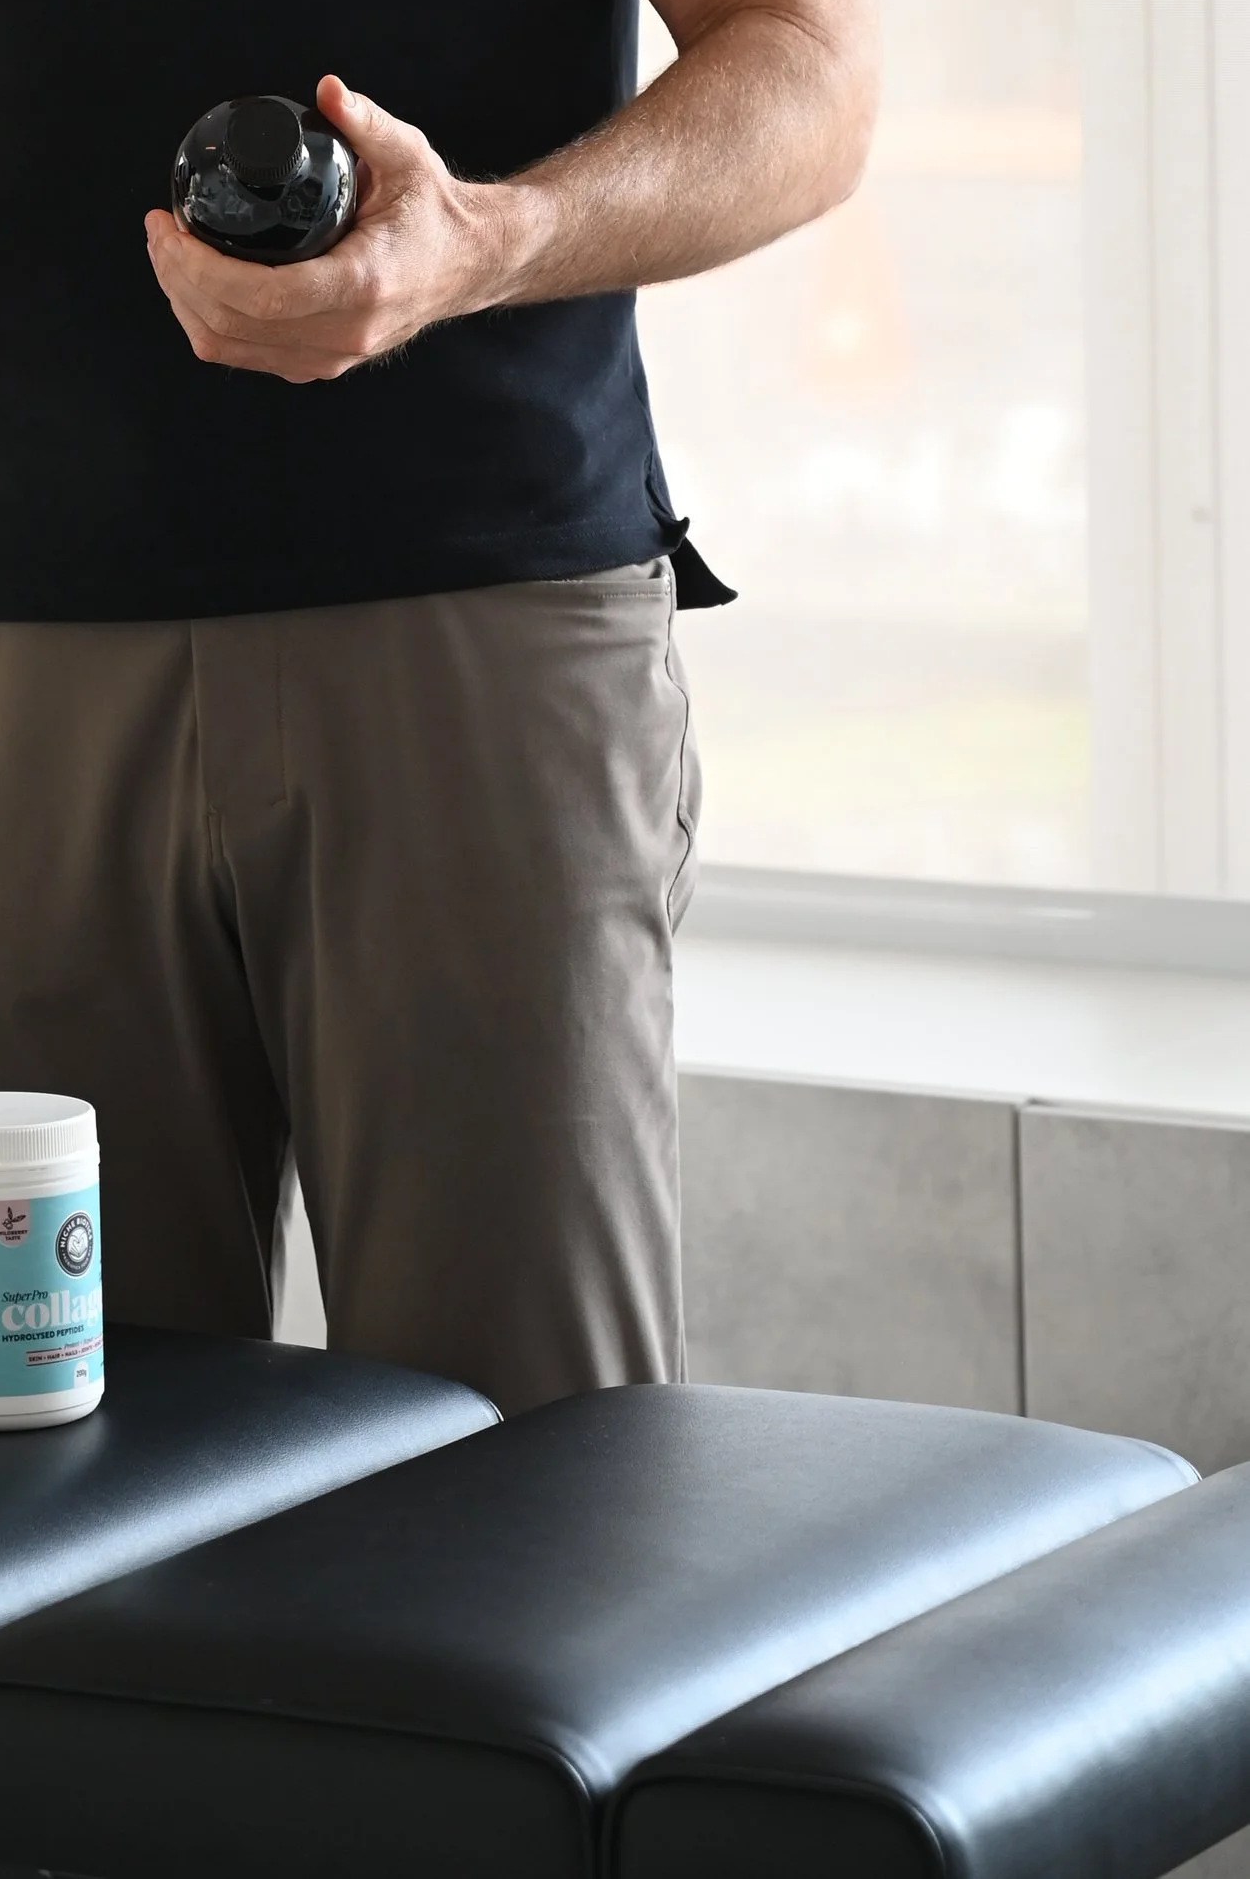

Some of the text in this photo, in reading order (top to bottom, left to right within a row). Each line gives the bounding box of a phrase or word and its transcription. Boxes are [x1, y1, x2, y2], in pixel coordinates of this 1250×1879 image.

[60, 1220, 76, 1248] NICHE
[2, 1290, 48, 1303] SuperPro
[2, 1325, 84, 1342] HYDROLYSED PEPTIDES
[76, 1369, 87, 1377] 200g
